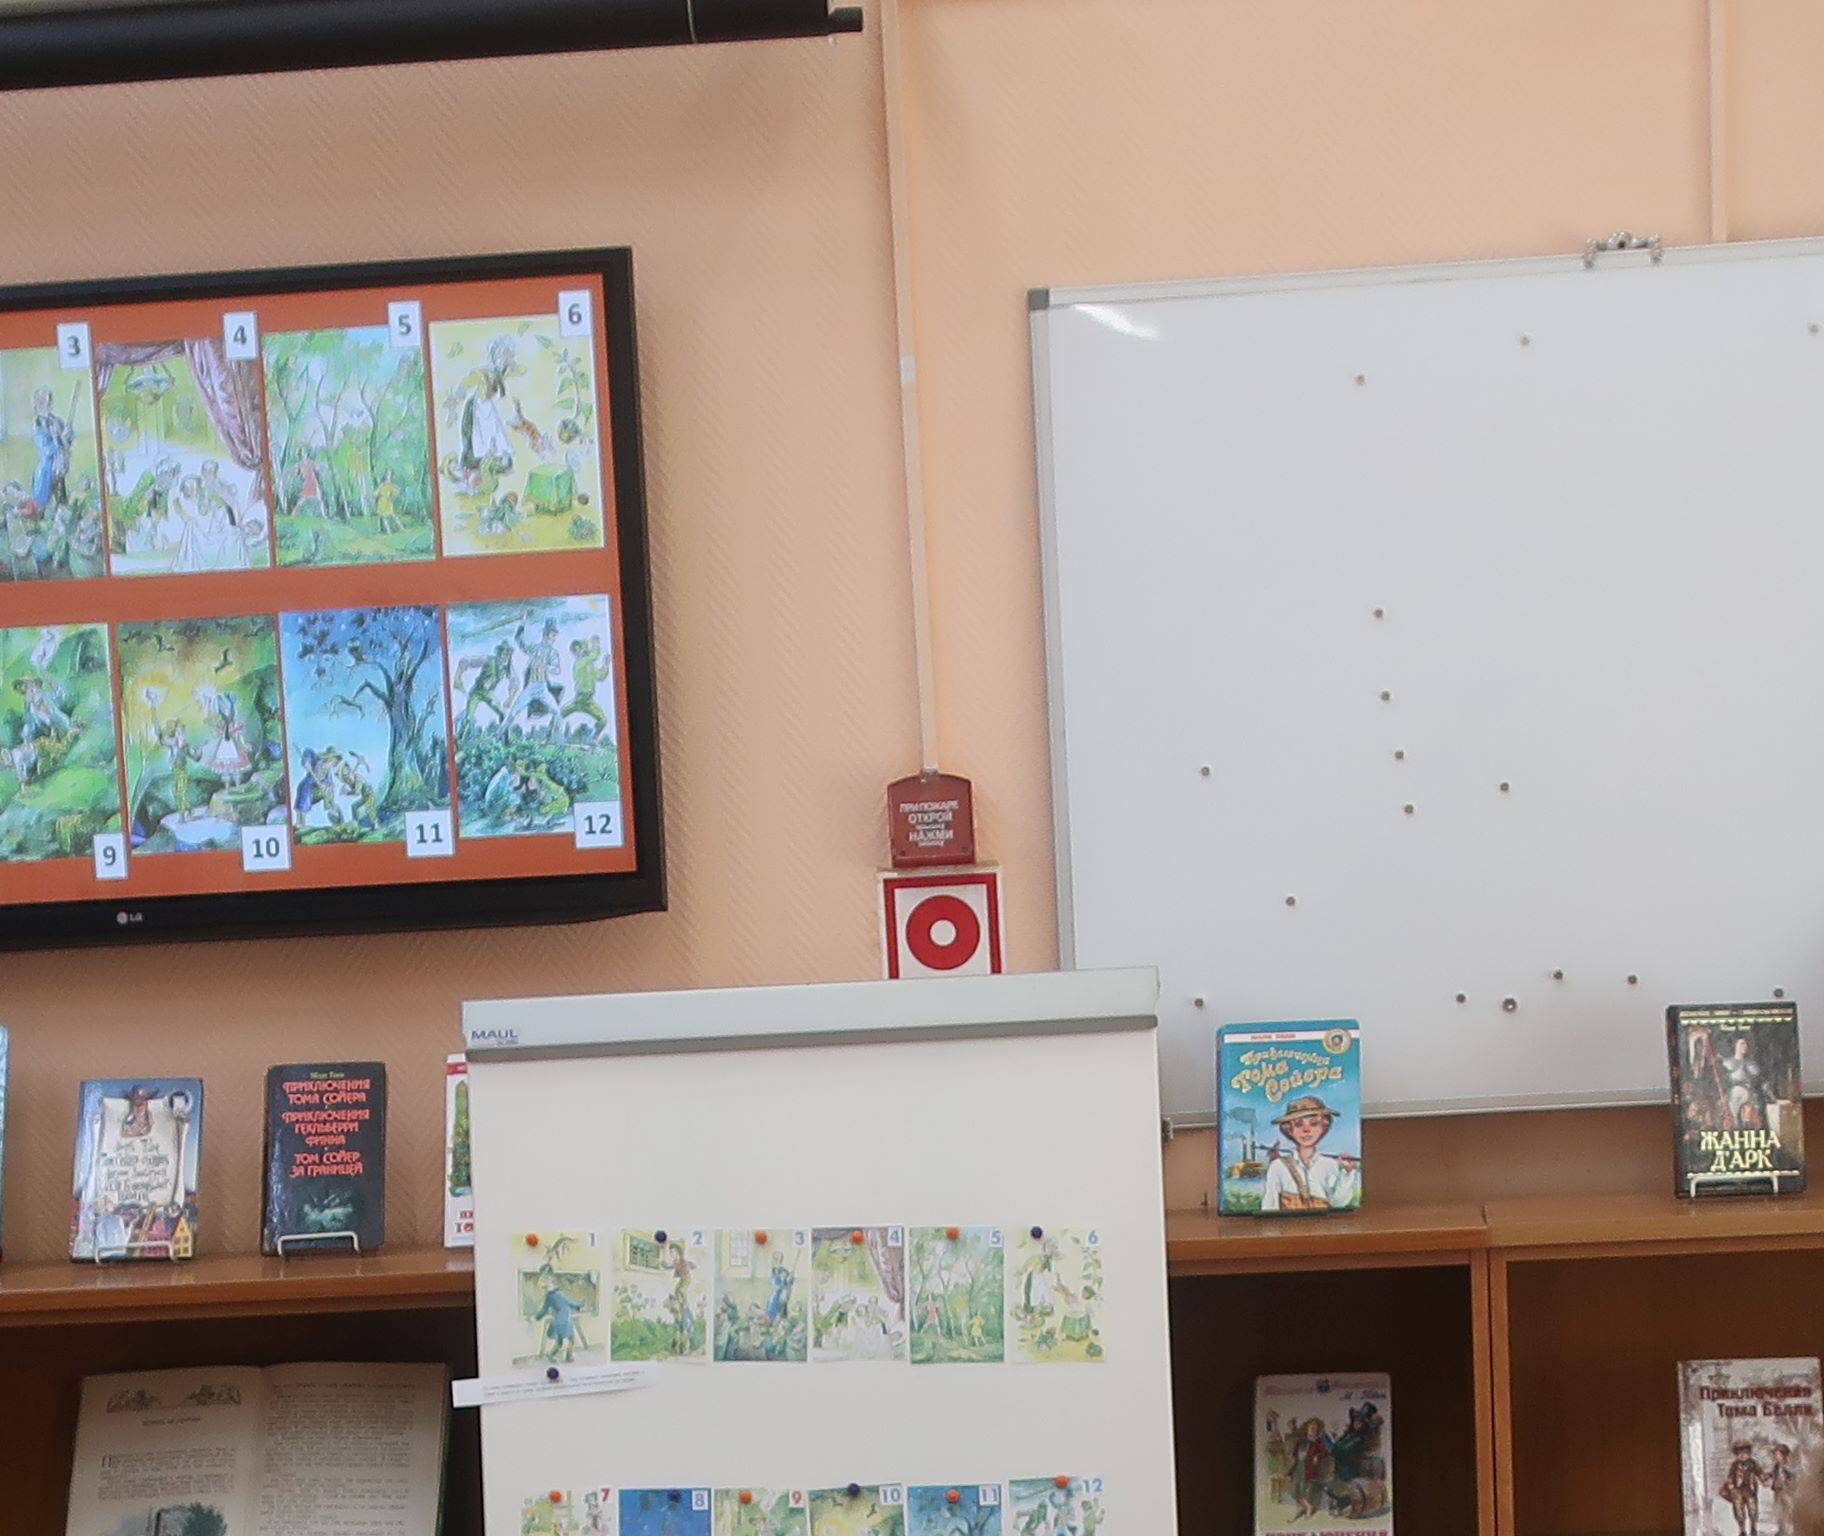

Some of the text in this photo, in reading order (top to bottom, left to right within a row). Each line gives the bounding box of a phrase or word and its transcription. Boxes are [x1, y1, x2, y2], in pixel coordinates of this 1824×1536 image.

[567, 303, 583, 326] 6
[398, 314, 412, 337] 5
[233, 325, 248, 346] 4
[67, 335, 81, 358] 3
[584, 813, 613, 835] 12
[415, 822, 444, 844] 11
[252, 837, 280, 859] 10
[102, 845, 117, 867] 9
[471, 1029, 518, 1039] MAUL
[1700, 1130, 1781, 1151] ЖАННА
[588, 1233, 596, 1247] 1
[692, 1231, 704, 1246] 2
[794, 1231, 805, 1246] 3
[889, 1230, 900, 1244] 4
[991, 1230, 1002, 1245] 5
[1087, 1230, 1099, 1245] 6
[1081, 1478, 1104, 1494] 12
[600, 1487, 611, 1502] 7
[694, 1493, 705, 1508] 8
[791, 1490, 802, 1505] 9
[881, 1488, 901, 1504] 10
[980, 1488, 1000, 1503] 11
